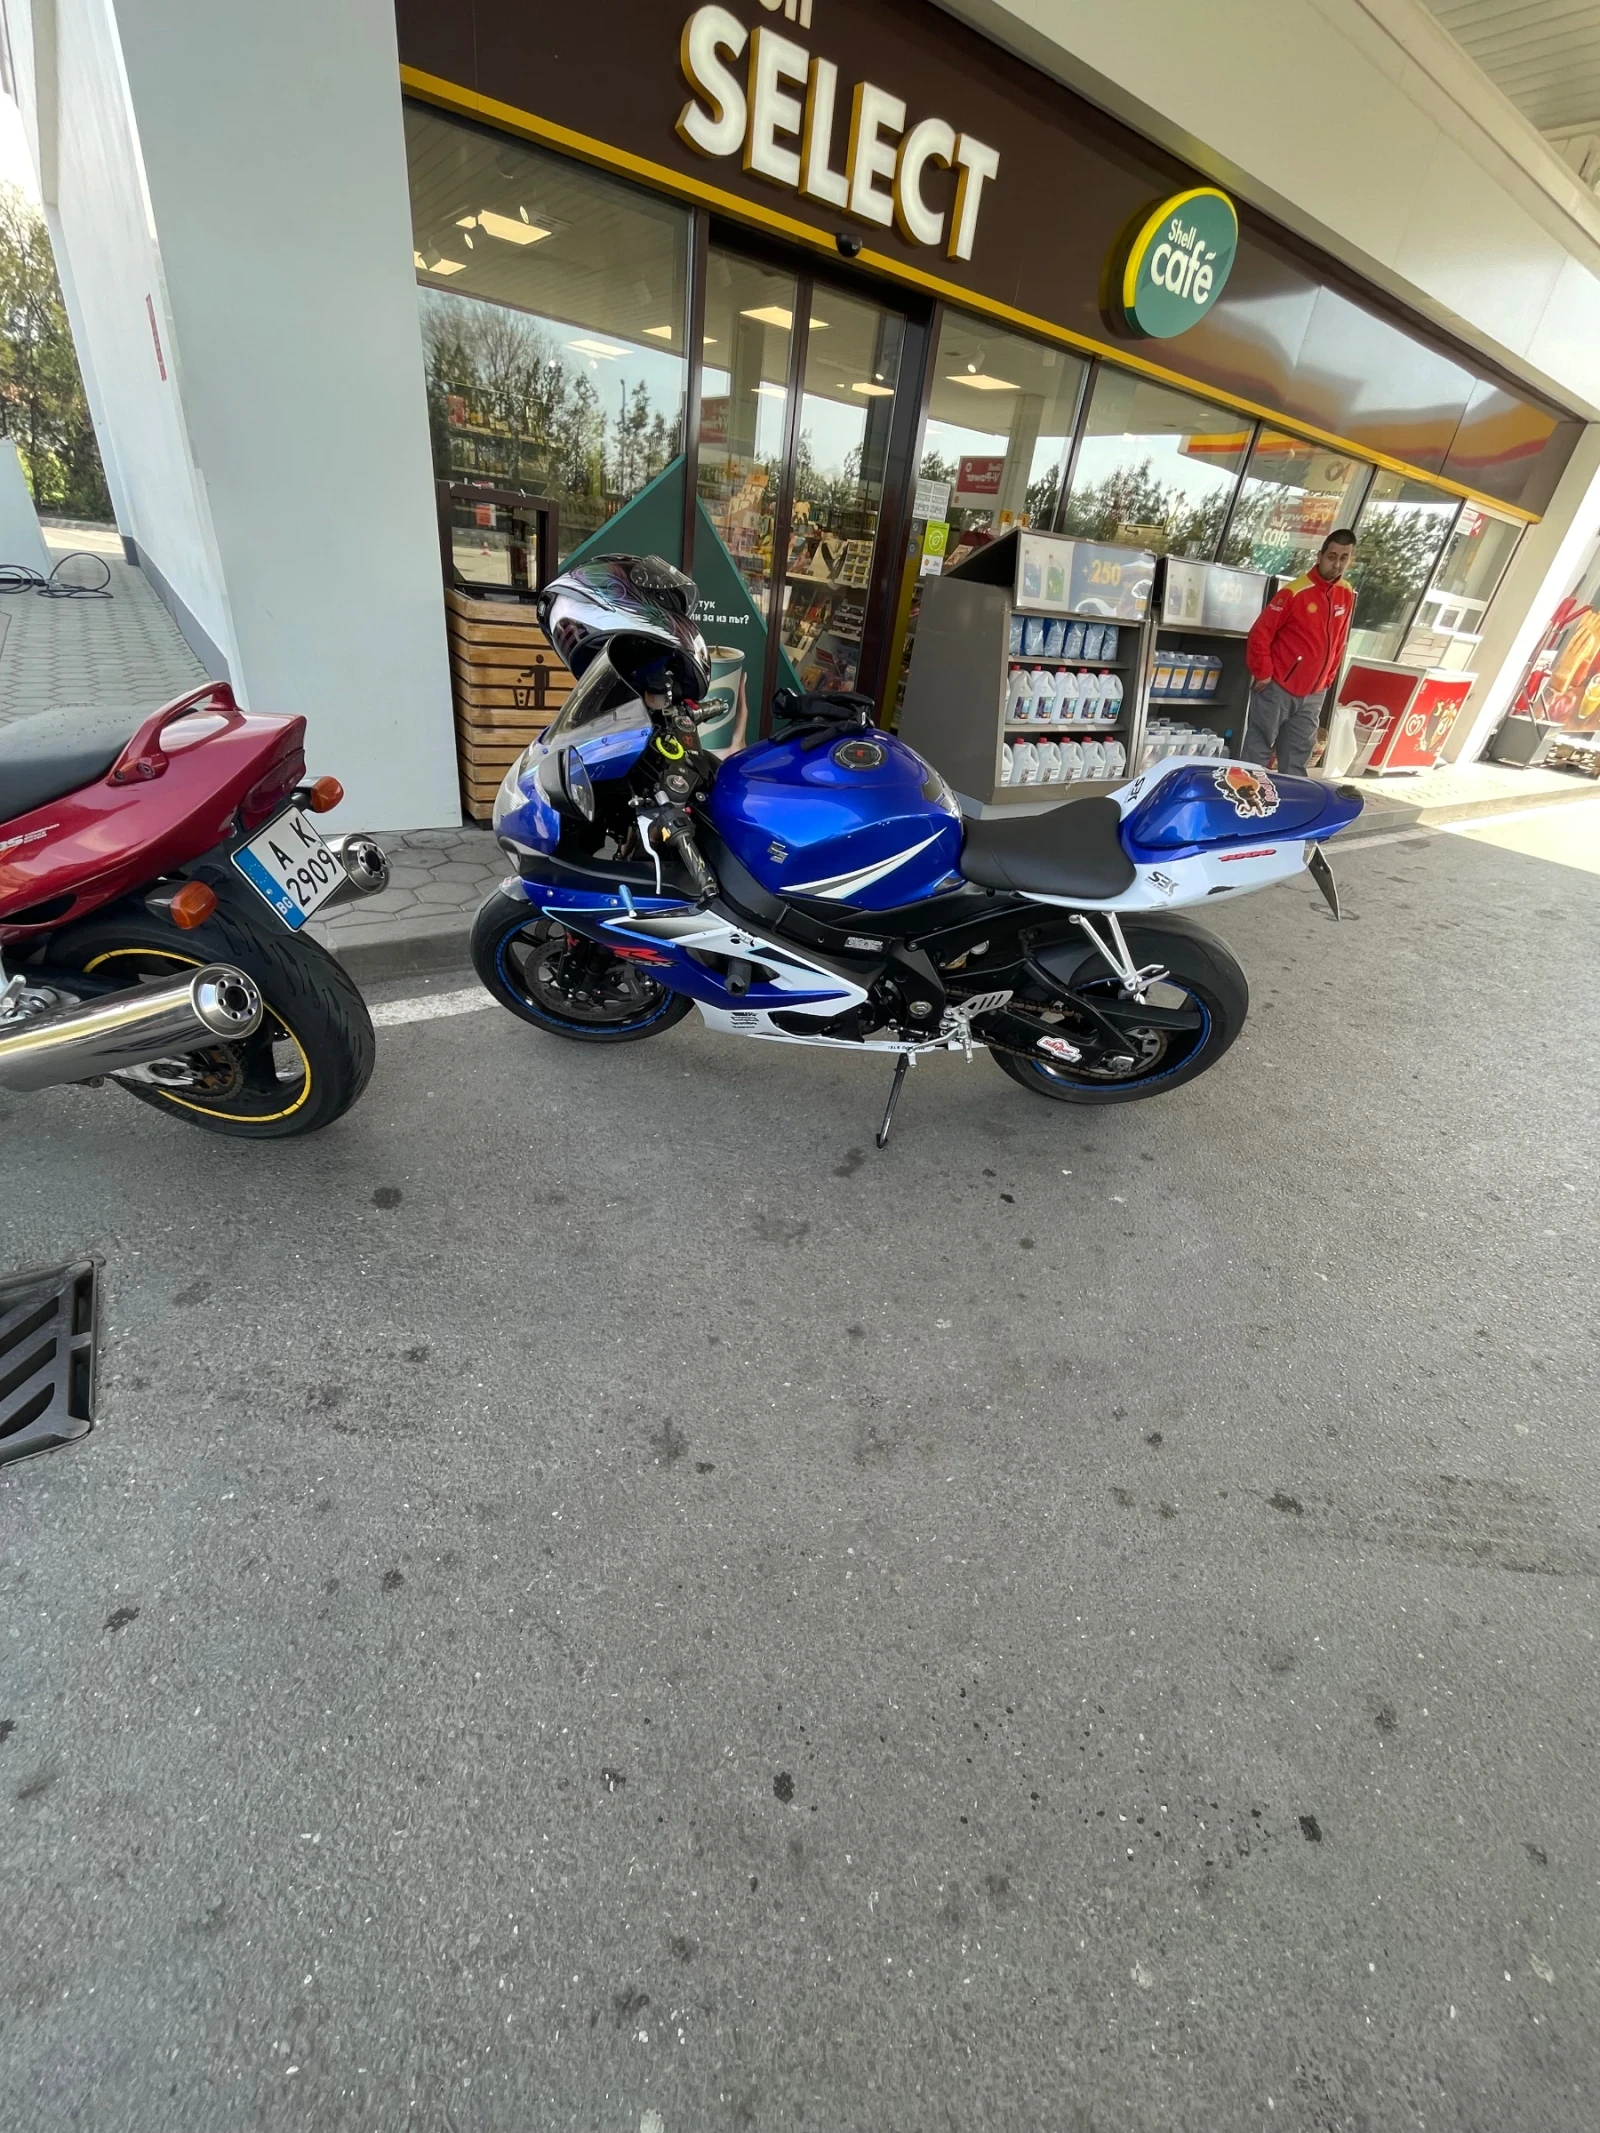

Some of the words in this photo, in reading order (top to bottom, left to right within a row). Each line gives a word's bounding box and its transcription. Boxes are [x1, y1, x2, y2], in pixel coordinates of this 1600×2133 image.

[675, 4, 999, 261] SELECT
[1168, 218, 1197, 251] Shell
[1151, 240, 1217, 305] café
[698, 600, 716, 611] тук
[702, 613, 715, 622] за
[716, 614, 727, 623] из
[728, 614, 750, 625] път?
[268, 840, 294, 871] A
[289, 816, 317, 849] K
[286, 848, 337, 908] 2909
[1147, 870, 1181, 894] SBK
[275, 896, 293, 915] BG
